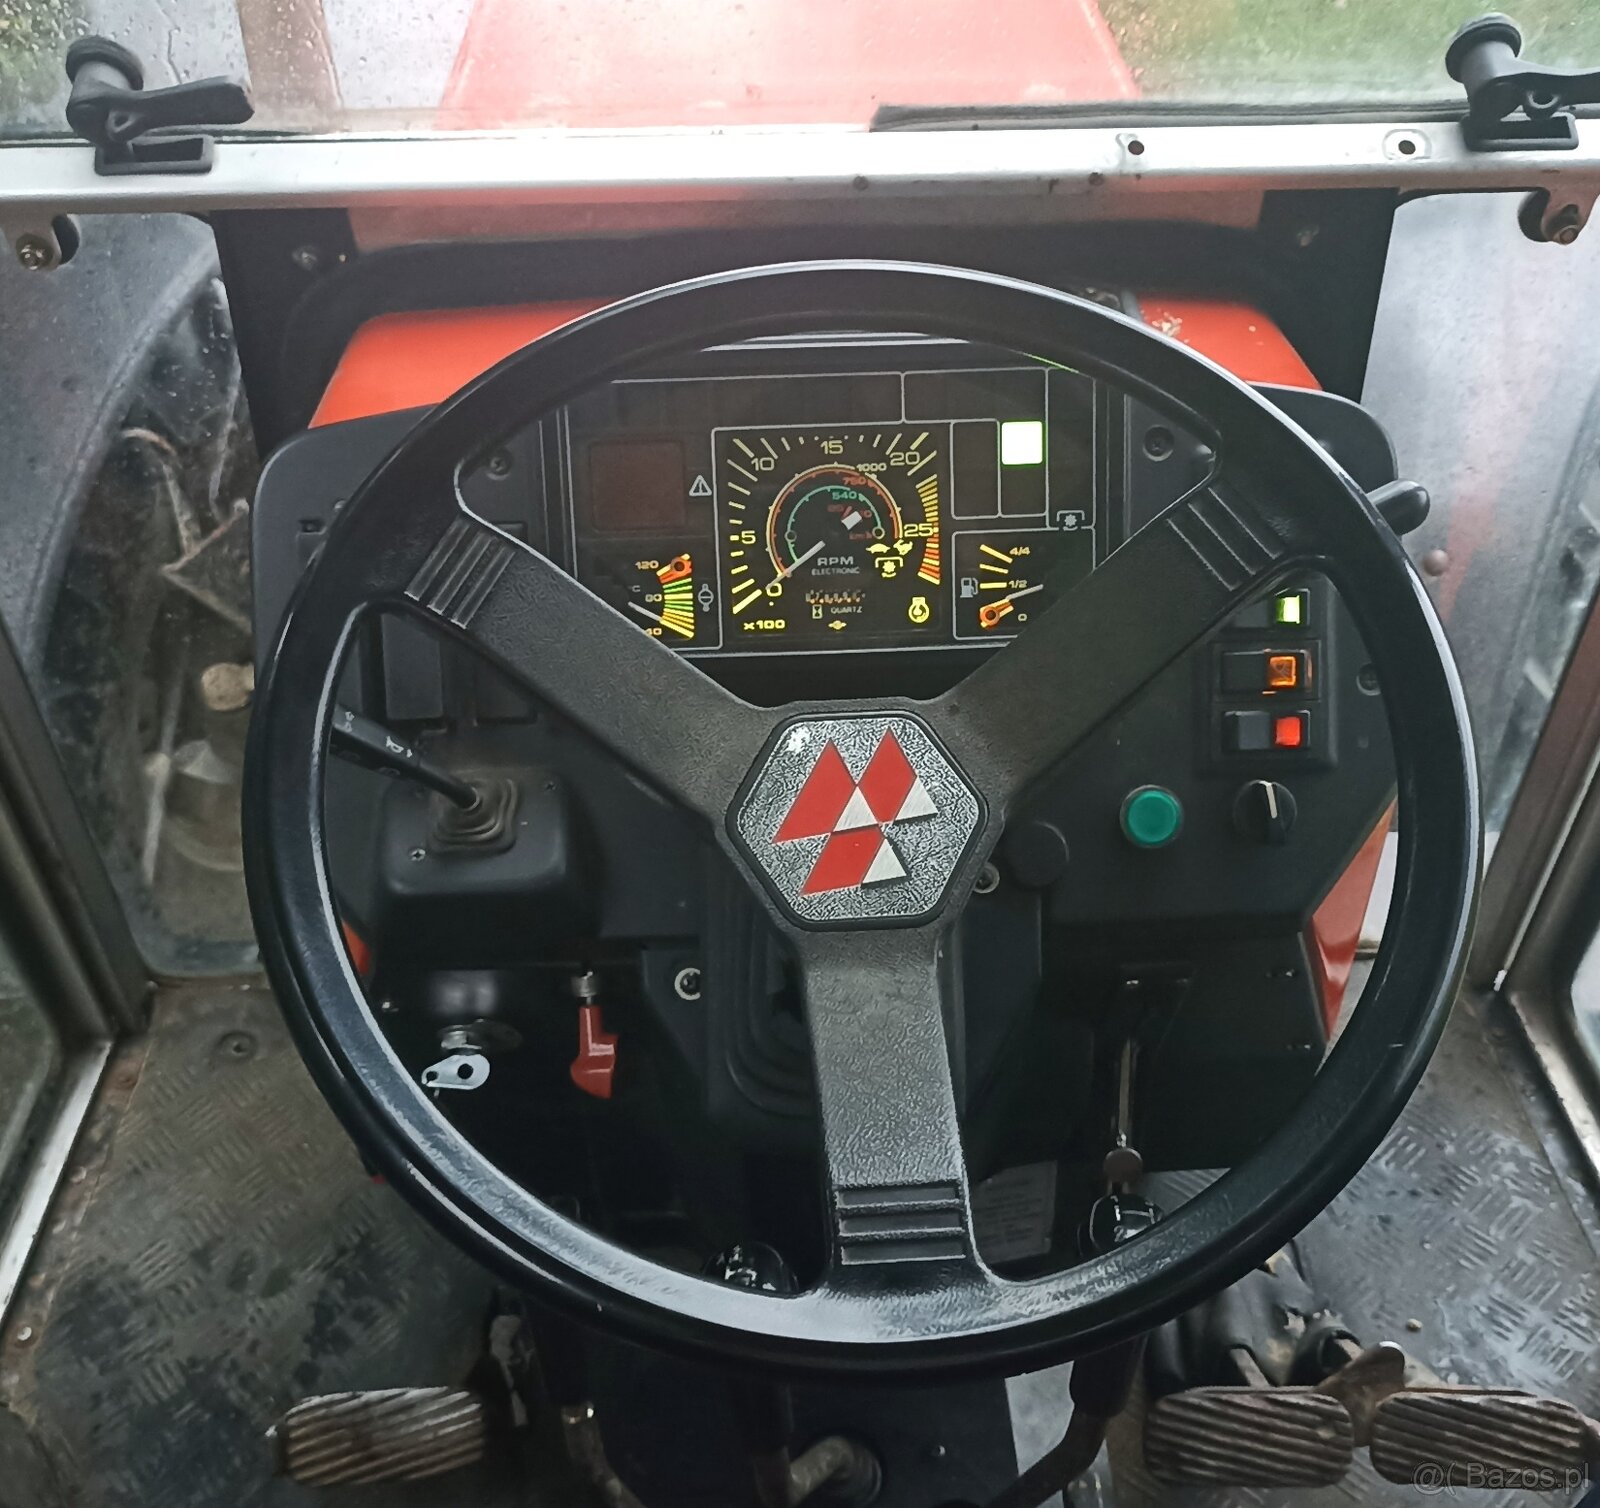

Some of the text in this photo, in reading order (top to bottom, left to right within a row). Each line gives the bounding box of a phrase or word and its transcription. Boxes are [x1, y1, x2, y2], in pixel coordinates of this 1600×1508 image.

[820, 440, 844, 455] 15
[750, 457, 775, 471] 10
[889, 451, 921, 466] 20
[856, 463, 887, 472] 1000
[832, 490, 858, 500] 540
[903, 523, 933, 537] 25
[741, 530, 756, 544] 5
[1009, 546, 1031, 556] 4/4
[635, 559, 660, 570] 120
[817, 555, 854, 566] RPM
[811, 566, 860, 576] ELECTRONIC
[766, 582, 783, 597] 0
[1008, 579, 1028, 589] 1/2
[830, 605, 863, 614] QUARTZ
